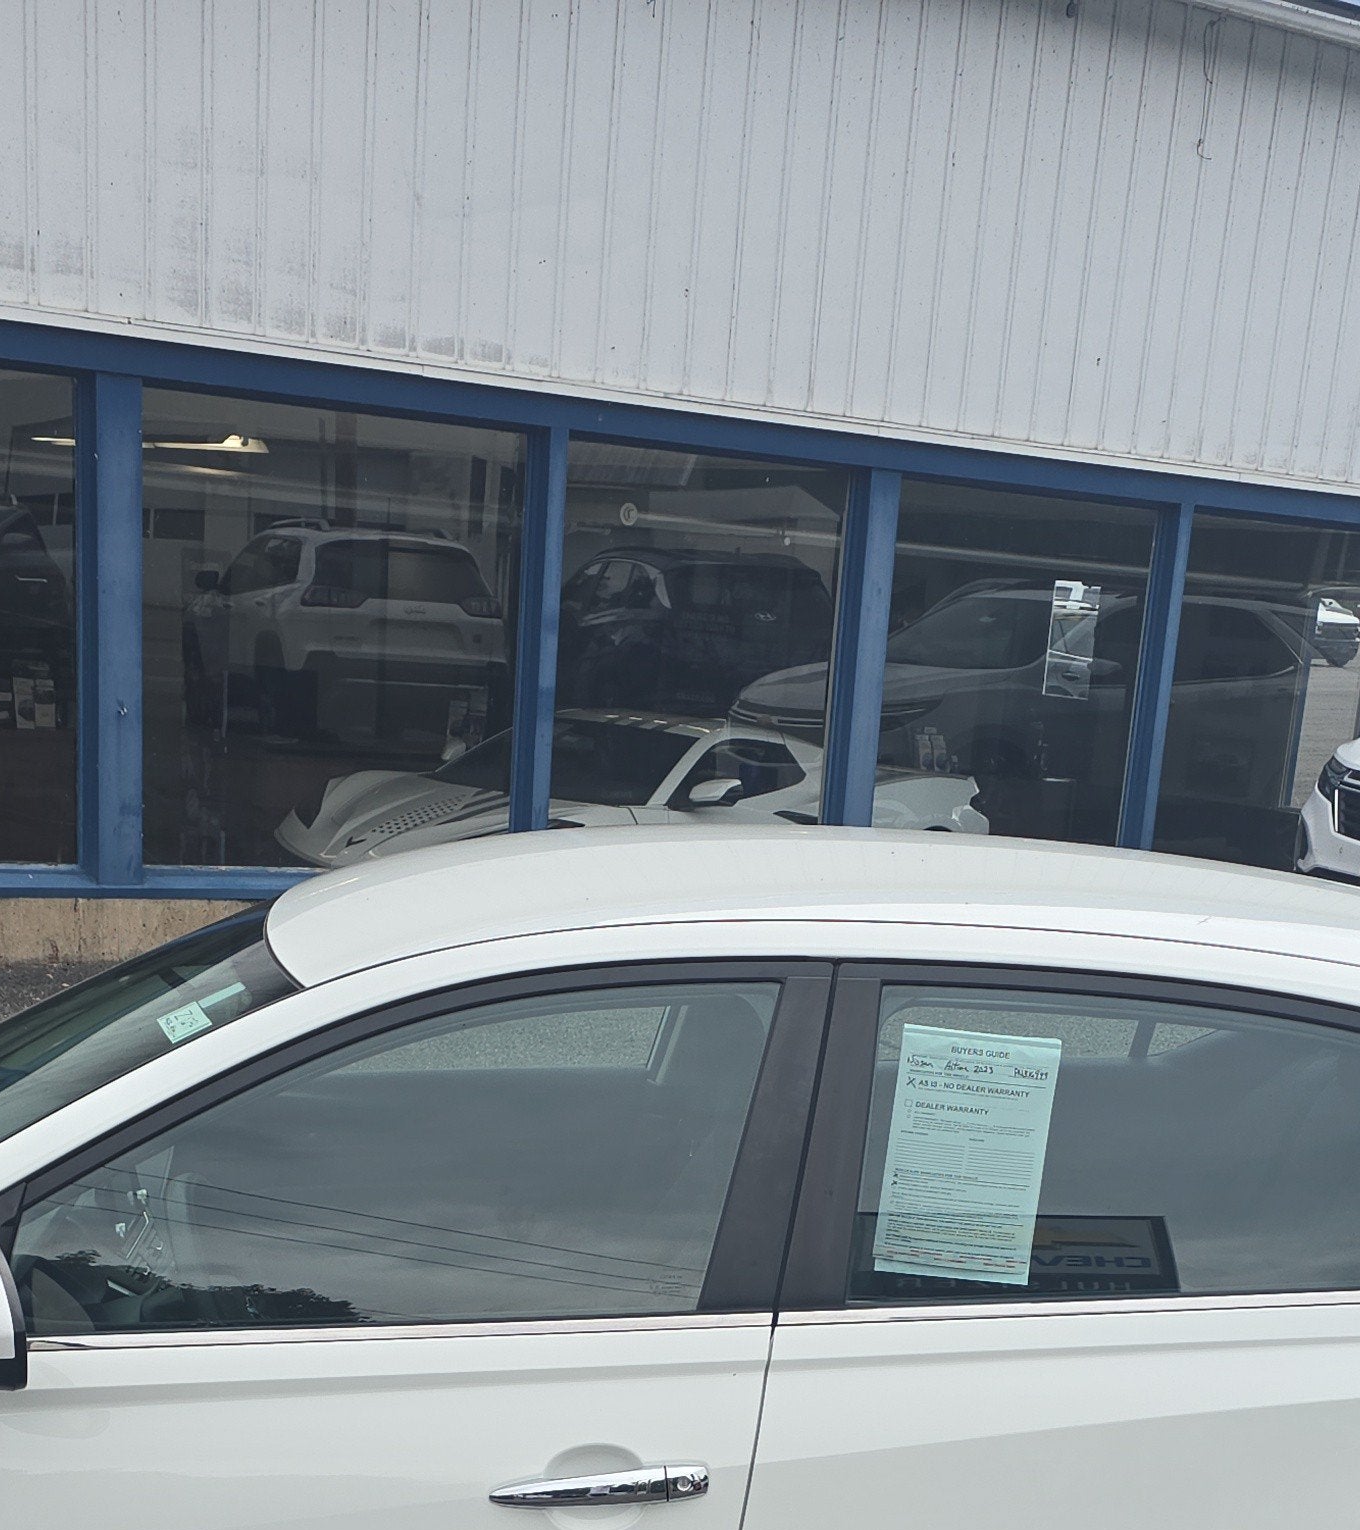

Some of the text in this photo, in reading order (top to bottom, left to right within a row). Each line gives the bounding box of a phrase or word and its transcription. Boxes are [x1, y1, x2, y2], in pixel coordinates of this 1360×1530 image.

[951, 1046, 1011, 1060] BUYERS GUIDE
[956, 1083, 986, 1093] DEALER
[987, 1087, 1030, 1098] WARRANTY
[915, 1101, 945, 1111] DEALER
[946, 1105, 990, 1115] WARRANTY
